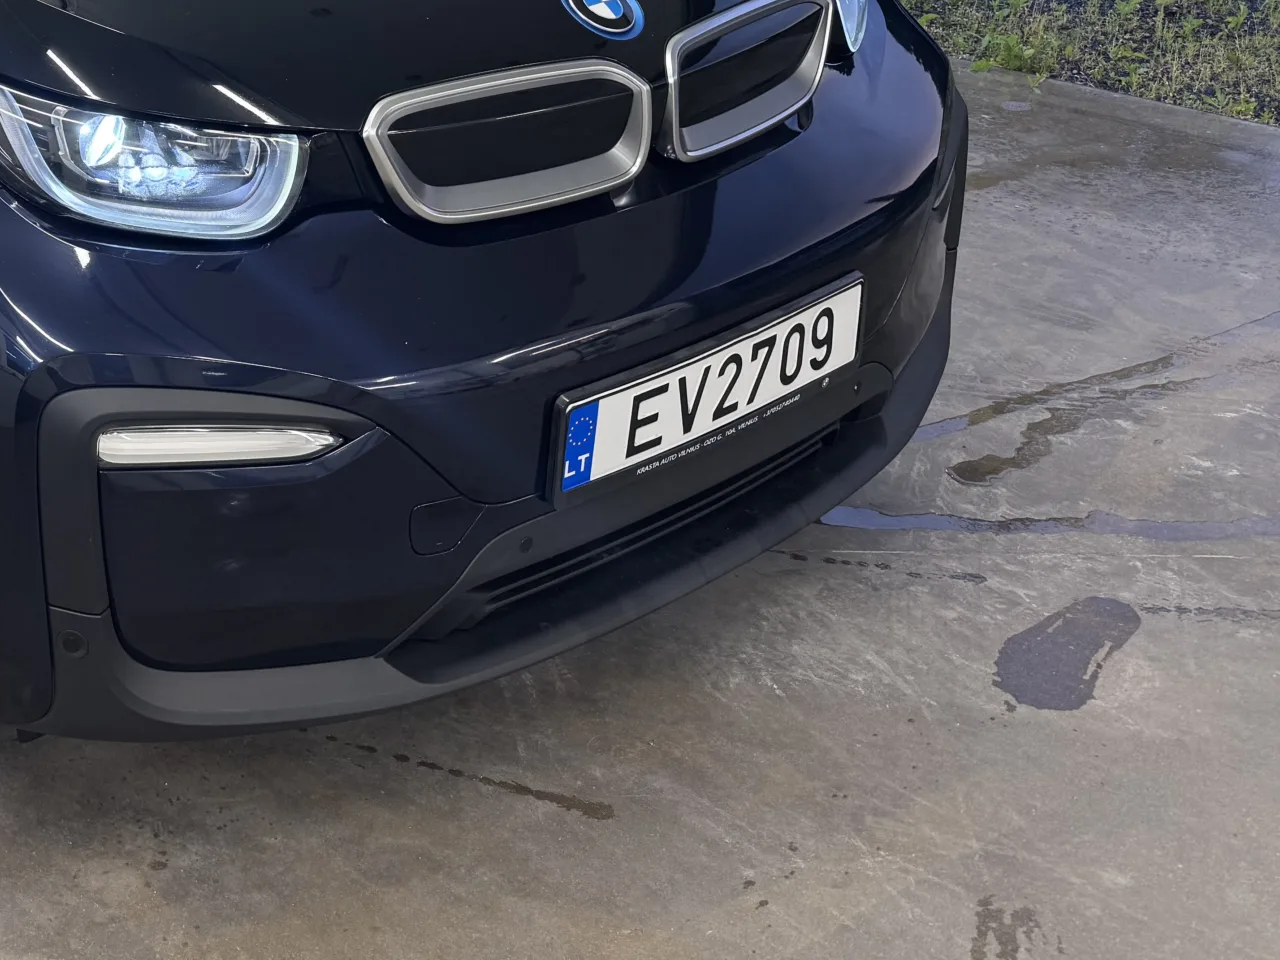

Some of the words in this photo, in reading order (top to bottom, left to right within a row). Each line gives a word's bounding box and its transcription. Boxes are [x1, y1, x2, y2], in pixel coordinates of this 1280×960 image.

[625, 306, 835, 460] EV2709
[563, 452, 590, 478] LT
[636, 460, 660, 476] KRASTA
[660, 453, 677, 466] AUTO
[678, 443, 700, 458] VILNIUS
